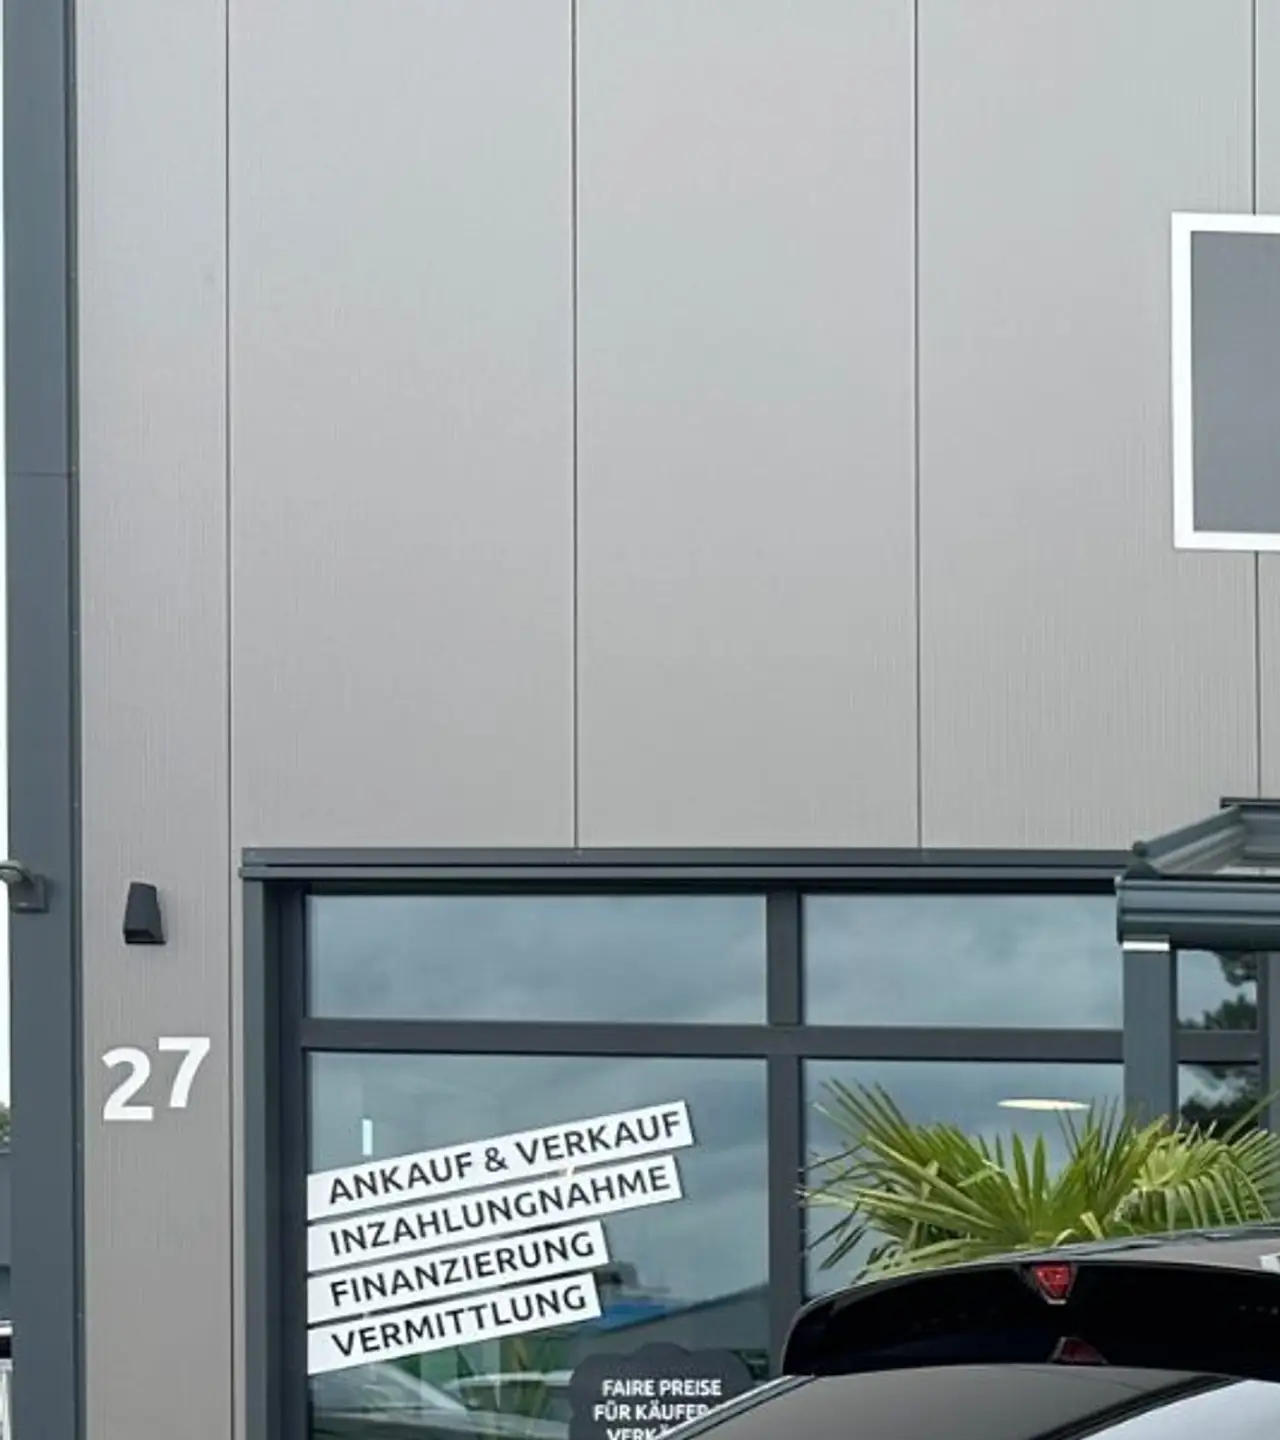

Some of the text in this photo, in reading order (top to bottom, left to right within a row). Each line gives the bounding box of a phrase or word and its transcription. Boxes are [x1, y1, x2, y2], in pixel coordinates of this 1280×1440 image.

[102, 1036, 211, 1121] 27
[329, 1110, 681, 1204] ANKAUF & VERKAUF
[329, 1164, 671, 1255] INZAHLUNGNAHME
[330, 1231, 595, 1307] FINANZIERUNG
[331, 1285, 587, 1357] VERMITTLUNG
[593, 1399, 632, 1421] FÜR
[602, 1379, 722, 1396] FAIRE PREISE
